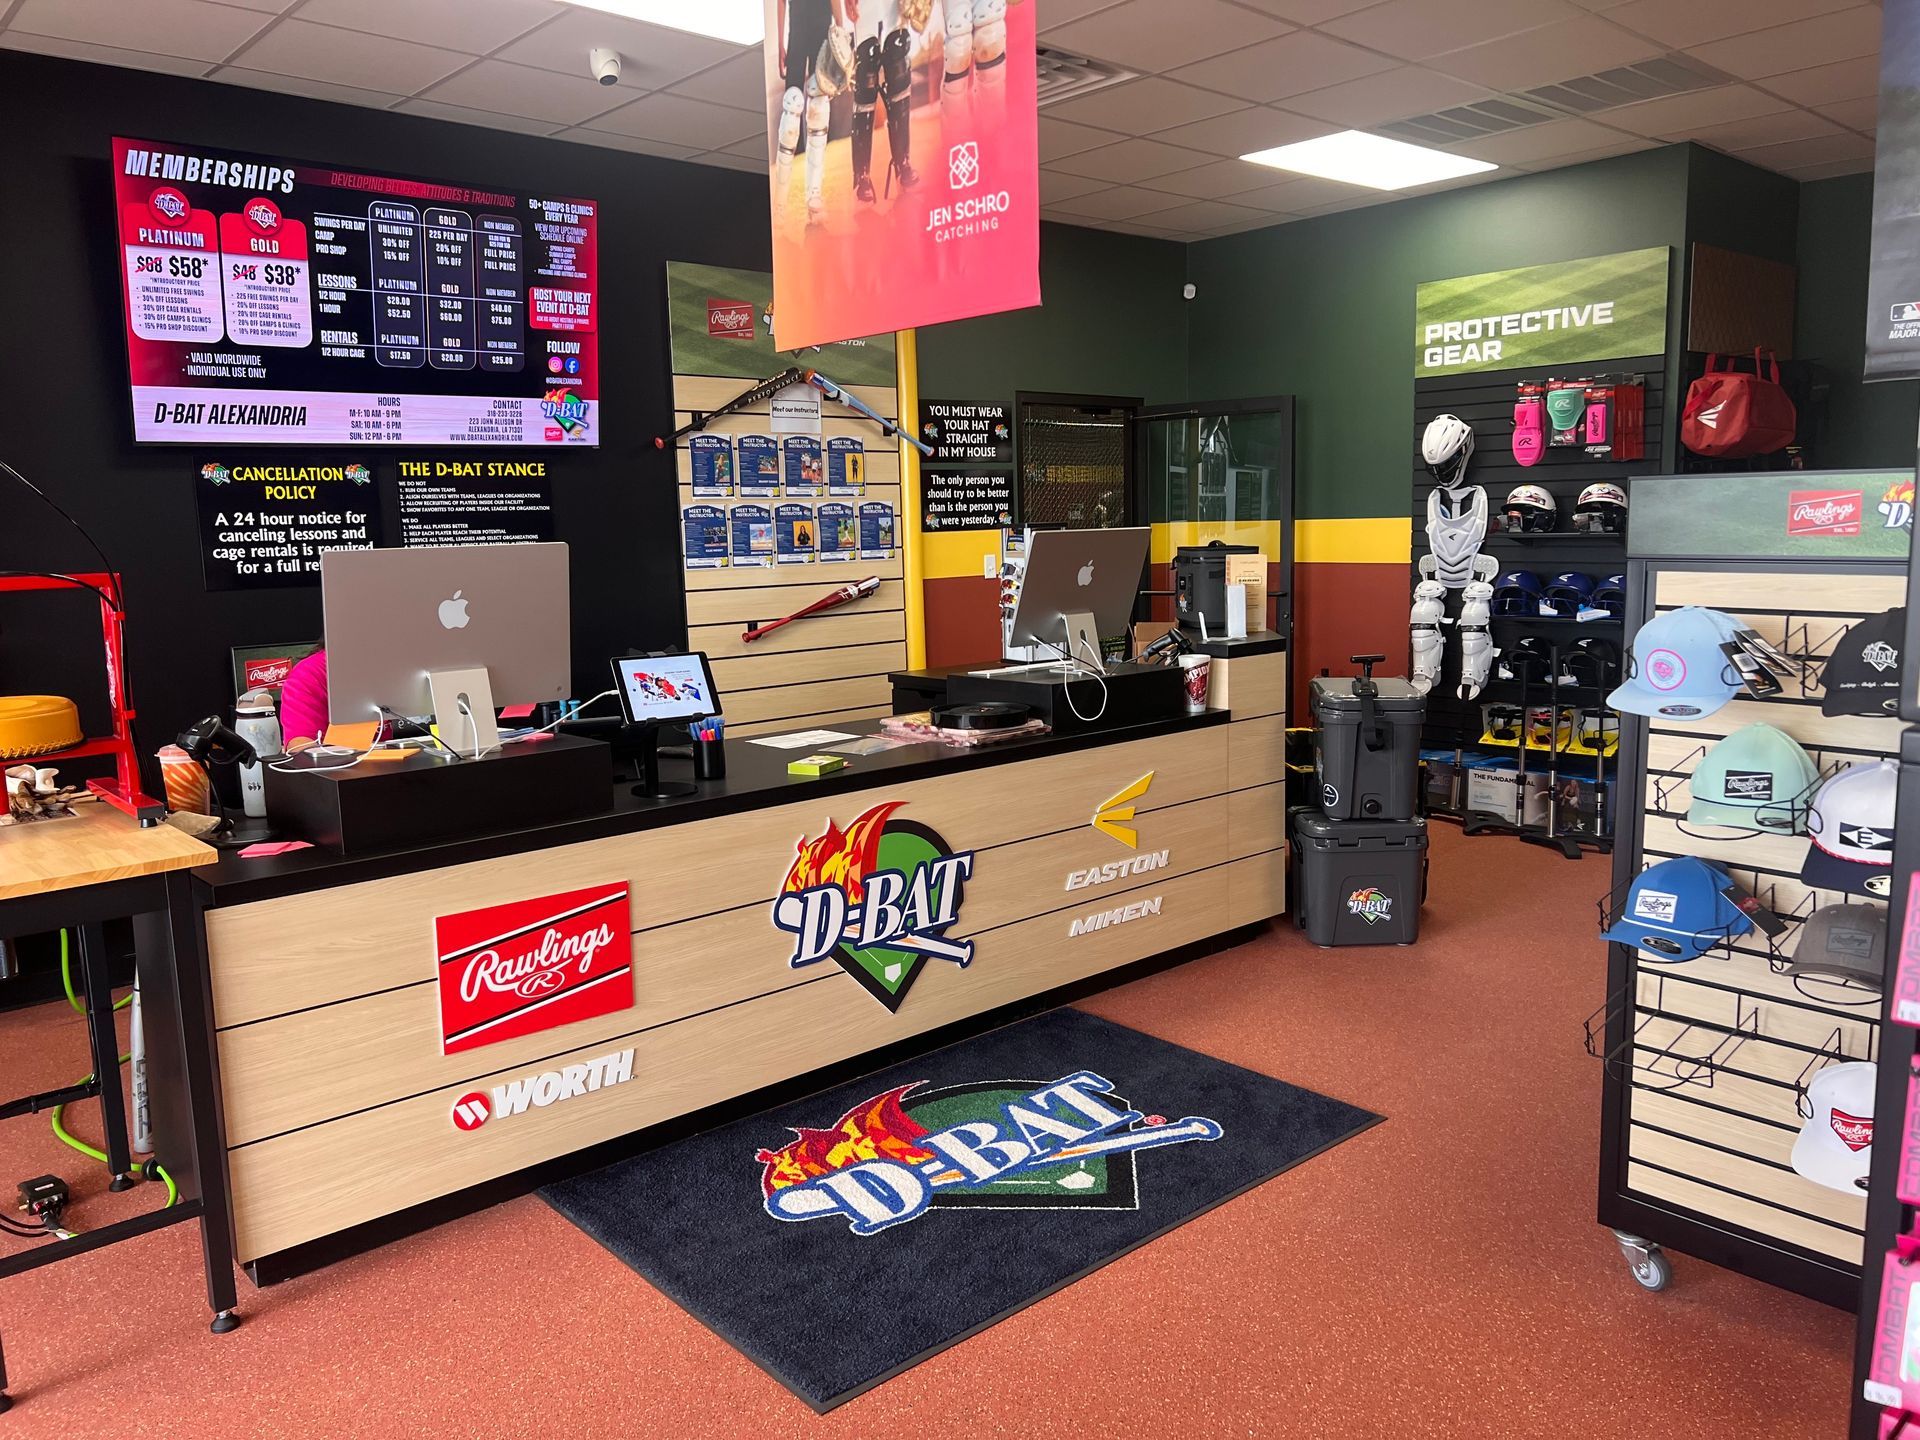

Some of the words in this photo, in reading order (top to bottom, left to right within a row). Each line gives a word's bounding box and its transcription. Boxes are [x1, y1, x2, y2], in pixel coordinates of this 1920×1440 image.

[125, 149, 295, 193] MEMBERSHIPS
[375, 207, 414, 221] PLATINUM
[543, 201, 564, 212] CAMPS
[926, 205, 951, 231] JEN
[955, 191, 1010, 220] SCHRO
[439, 215, 456, 226] GOLD
[545, 211, 563, 222] EVERY
[564, 214, 578, 224] YEAR
[378, 224, 413, 236] UNLIMITED
[935, 217, 999, 243] CATCHING
[139, 228, 204, 248] PLATINUM
[251, 238, 279, 254] GOLD
[233, 264, 258, 280] $48
[318, 273, 357, 289] LESSONS
[534, 288, 552, 300] HOST
[554, 290, 572, 302] YOUR
[574, 292, 591, 304] NEXT
[537, 301, 558, 313] EVENT
[559, 303, 568, 314] AT
[569, 303, 589, 315] D-BAT
[711, 309, 750, 329] Rawlings
[1425, 301, 1614, 345] PROTECTIVE
[321, 330, 358, 344] RENTALS
[1889, 329, 1918, 339] MAJOR
[546, 340, 580, 354] FOLLOW
[1424, 340, 1502, 368] GEAR
[191, 352, 212, 364] VALID
[214, 353, 261, 366] WORLDWIDE
[187, 365, 230, 377] INDIVIDUAL
[232, 367, 247, 378] USE
[249, 368, 266, 378] ONLY
[377, 397, 400, 406] HOURS
[493, 400, 522, 410] CONTACT
[154, 403, 205, 424] D-BAT
[208, 404, 307, 426] ALEXANDRIA
[364, 409, 371, 418] 10
[371, 410, 382, 418] AM
[391, 410, 401, 418] PM
[545, 401, 588, 418] D-BAT
[929, 406, 949, 416] YOU
[952, 406, 976, 417] MUST
[978, 407, 1003, 418] WEAR
[351, 421, 363, 429] SAT:
[364, 421, 371, 429] 10
[372, 421, 382, 429] AM
[391, 421, 401, 430] PM
[944, 420, 969, 430] YOUR
[971, 420, 989, 430] HAT
[350, 432, 364, 441] SUN:
[364, 432, 371, 441] 12
[372, 432, 382, 441] PM
[391, 433, 402, 441] PM
[946, 433, 988, 444] STRAIGHT
[938, 447, 948, 457] IN
[951, 447, 965, 457] MY
[967, 447, 996, 457] HOUSE
[232, 466, 344, 481] CANCELLATION
[399, 462, 431, 477] THE
[436, 463, 483, 476] D-BAT
[488, 463, 546, 476] STANCE
[931, 475, 946, 485] The
[947, 475, 963, 487] only
[965, 477, 989, 487] person
[991, 476, 1005, 487] you
[265, 485, 317, 500] POLICY
[928, 489, 951, 499] should
[953, 490, 964, 500] try
[966, 490, 974, 498] to
[977, 489, 986, 498] be
[987, 488, 1009, 498] better
[929, 502, 946, 512] than
[948, 502, 954, 512] is
[955, 502, 967, 511] the
[969, 503, 993, 513] person
[995, 502, 1008, 513] you
[1794, 502, 1856, 521] Rawlings
[215, 512, 229, 527] A
[234, 512, 255, 526] 24
[260, 512, 294, 526] hour
[299, 511, 342, 526] notice
[345, 510, 367, 525] for
[941, 516, 959, 525] were
[961, 515, 997, 527] yesterday.
[219, 528, 286, 544] canceling
[290, 528, 338, 541] lessons
[341, 526, 367, 540] and
[213, 547, 246, 561] cage
[251, 543, 298, 558] rentals
[302, 543, 313, 556] is
[237, 561, 259, 574] for
[264, 563, 272, 573] a
[277, 559, 300, 573] full
[250, 666, 288, 681] Rawlings
[1727, 777, 1769, 791] Rawlings
[1857, 830, 1874, 846] E
[1065, 850, 1169, 892] EASTON
[795, 854, 972, 964] D-BAT
[1351, 899, 1390, 914] D-BAT
[1069, 896, 1163, 938] MIKEN
[460, 923, 615, 1002] Rawlings
[492, 1048, 636, 1119] WORTH
[817, 1073, 1131, 1228] D-BAT
